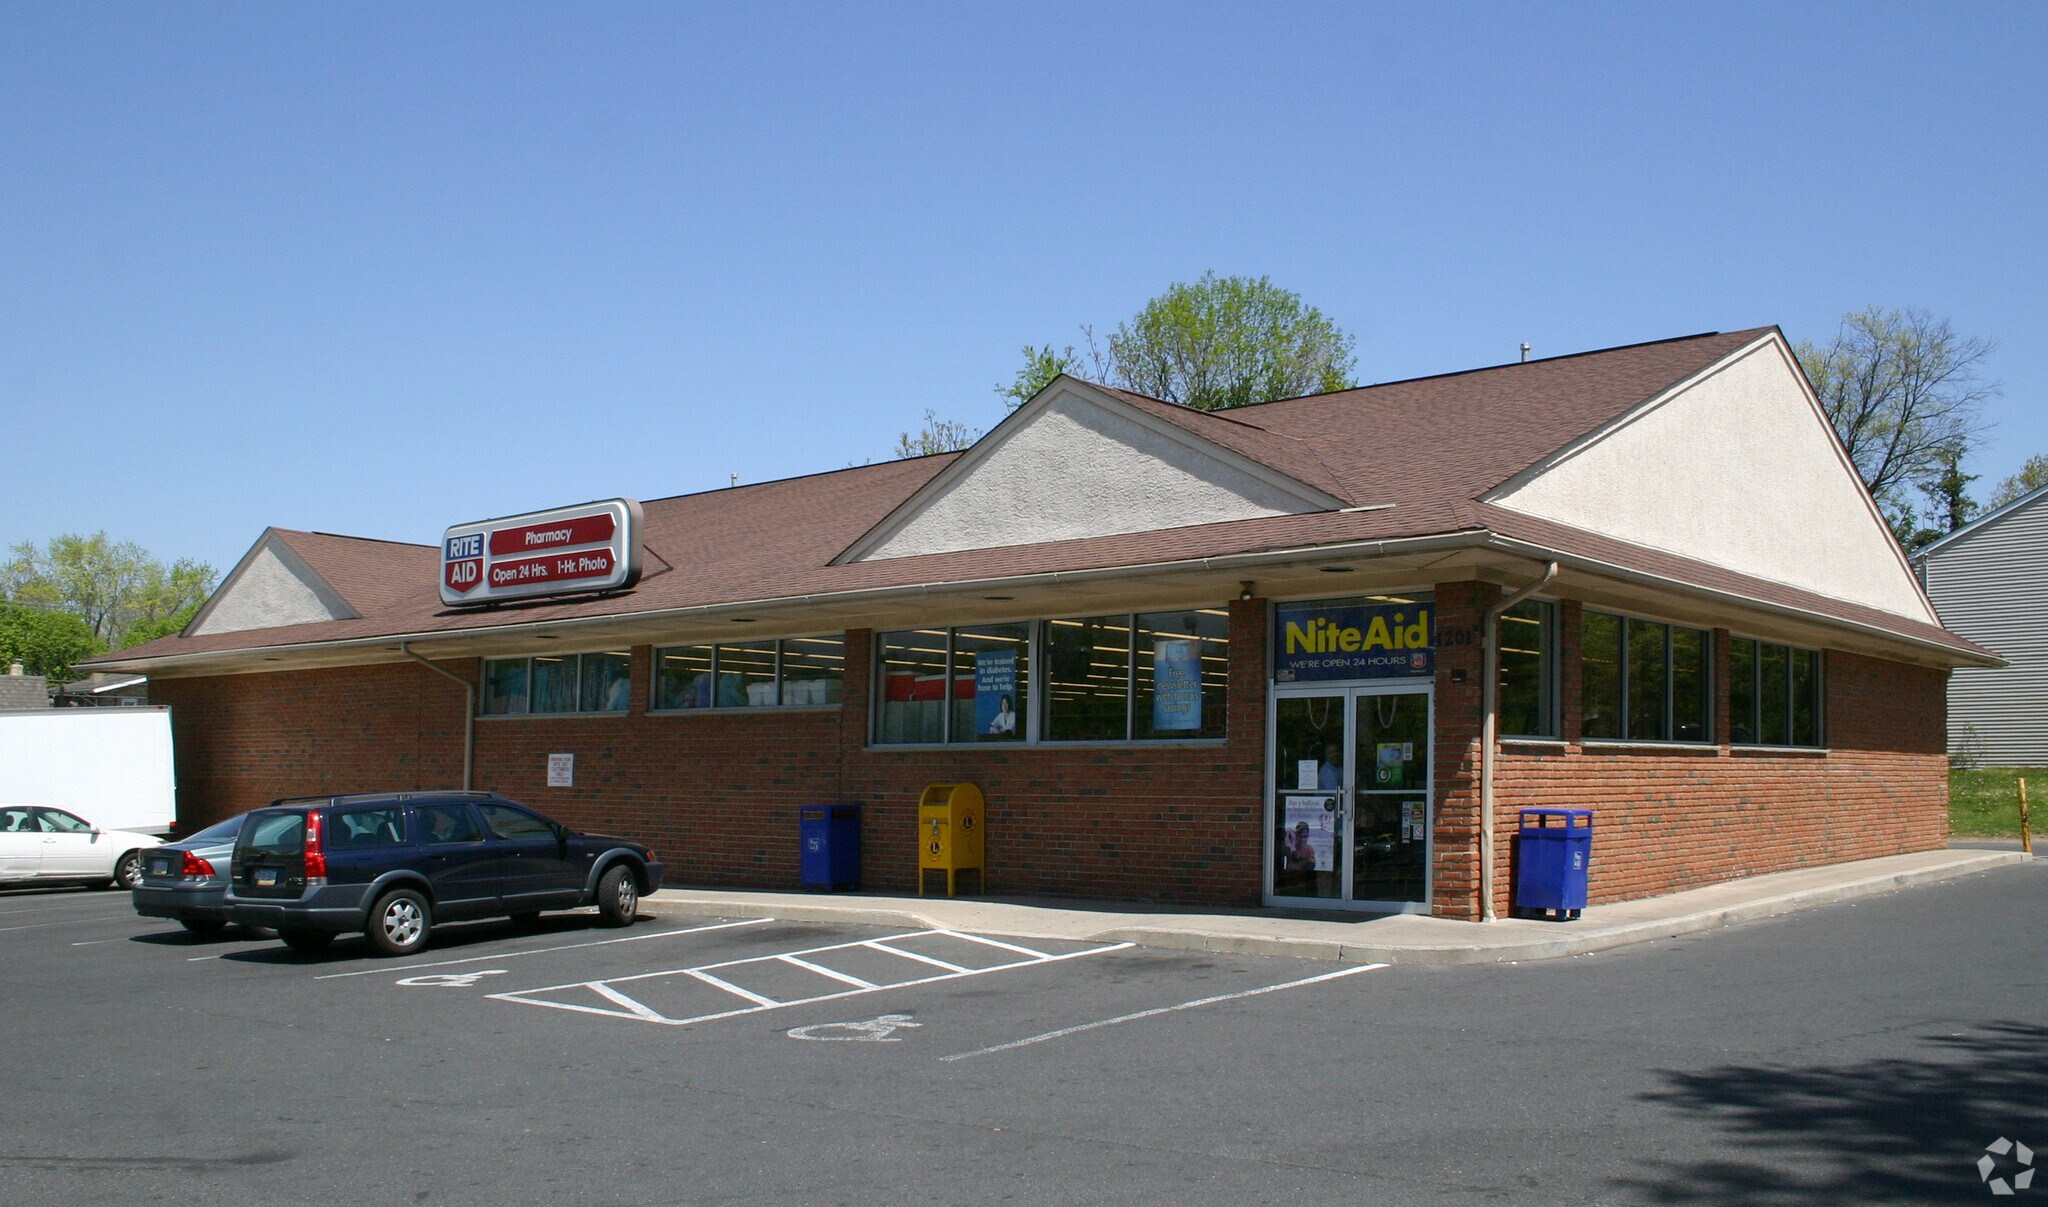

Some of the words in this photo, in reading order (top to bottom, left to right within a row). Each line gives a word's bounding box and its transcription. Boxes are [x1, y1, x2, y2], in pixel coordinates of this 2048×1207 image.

[525, 528, 572, 545] Pharmacy
[450, 535, 480, 558] RITE
[450, 561, 477, 584] AID
[493, 569, 517, 584] Open
[519, 565, 530, 578] 24
[531, 563, 548, 577] Hrs.
[557, 559, 577, 574] 1-Hr.
[579, 556, 608, 572] Photo
[1289, 659, 1320, 669] WE'RE
[1322, 658, 1350, 668] OPEN
[1353, 657, 1365, 666] 24
[1368, 656, 1406, 666] HOURS
[982, 675, 993, 683] And
[977, 684, 991, 692] here
